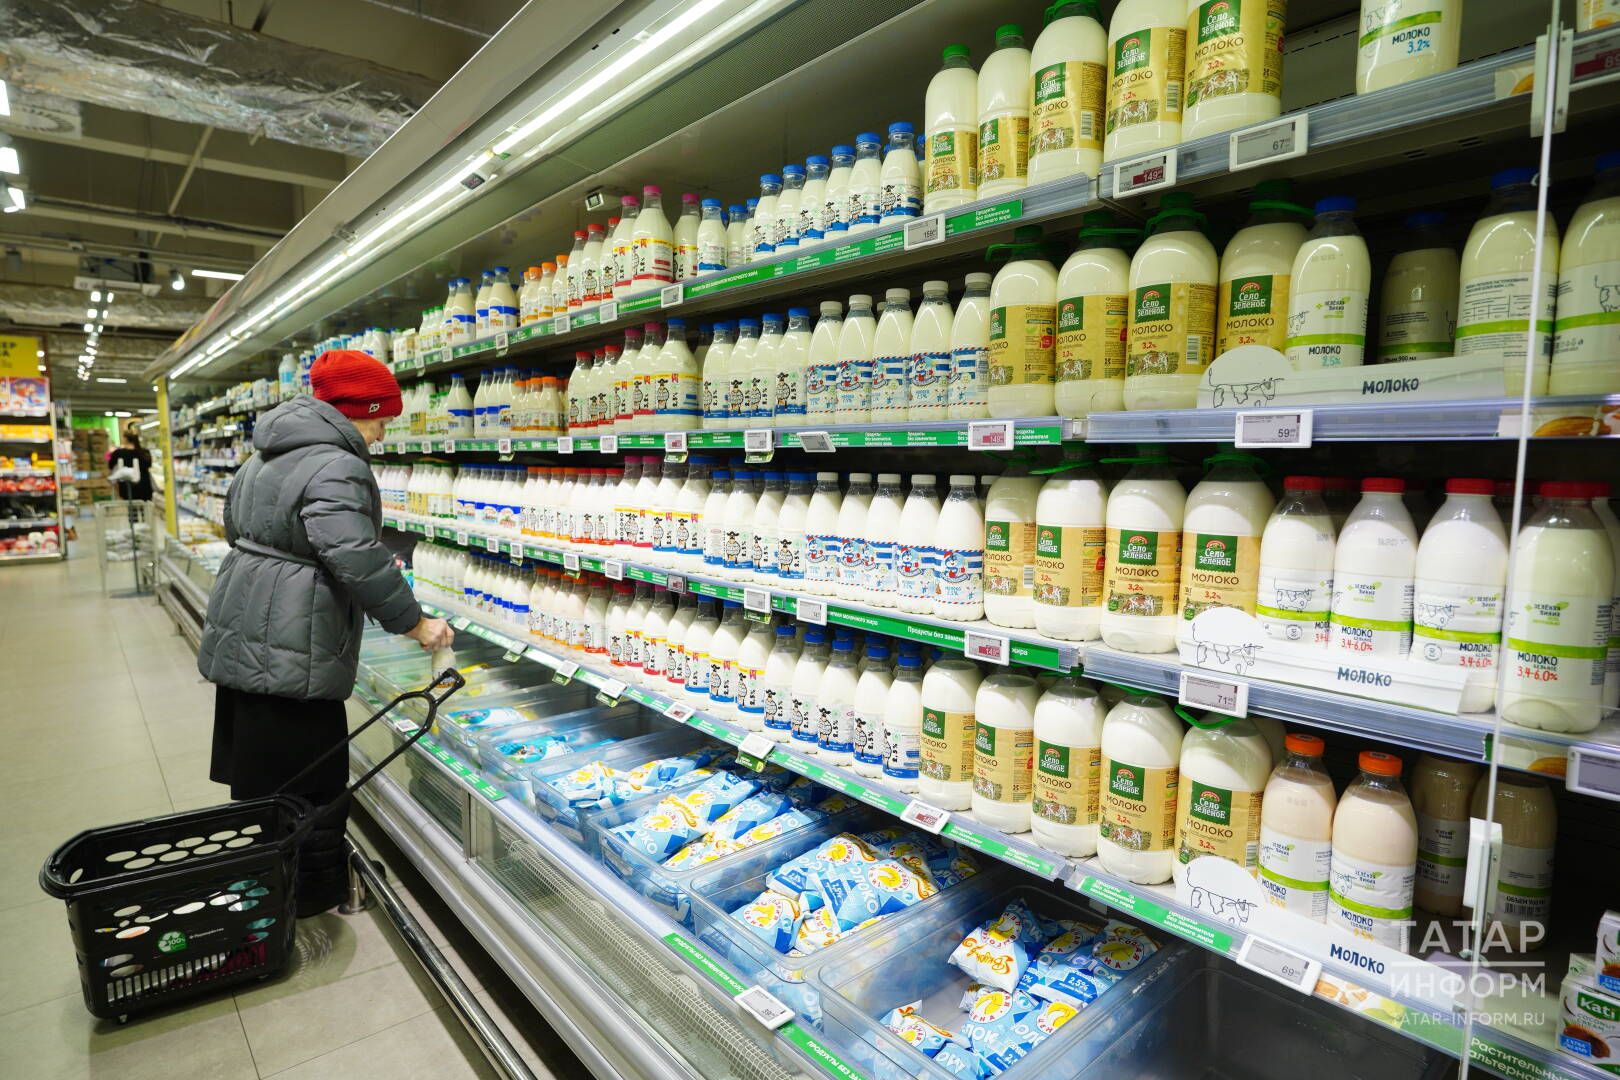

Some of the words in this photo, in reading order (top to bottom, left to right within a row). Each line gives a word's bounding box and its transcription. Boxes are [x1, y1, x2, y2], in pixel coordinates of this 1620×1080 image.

[1207, 12, 1227, 25] Село
[1392, 26, 1431, 44] МОЛОКО
[1194, 37, 1244, 60] МОЛОКО
[1407, 39, 1430, 54] 3.2%
[1111, 70, 1153, 91] МОЛОКО
[1239, 292, 1258, 302] Село
[1142, 300, 1159, 308] Село
[1132, 323, 1173, 336] МОЛОКО
[1226, 317, 1274, 330] МОЛОКО
[1308, 345, 1342, 355] МОЛОКО
[1362, 378, 1419, 395] МОЛОКО
[1128, 543, 1146, 552] Село
[1204, 548, 1224, 558] Село
[1116, 566, 1159, 578] МОЛОКО
[1192, 572, 1240, 585] МОЛОКО
[908, 626, 932, 638] Продукты
[934, 630, 944, 639] без
[1342, 626, 1372, 638] МОЛОКО
[1341, 638, 1372, 652] 3.4-6.0%
[1459, 643, 1493, 652] МОЛОКО
[1518, 652, 1558, 666] МОЛОКО
[1338, 667, 1392, 686] МОЛОКО
[1518, 666, 1558, 682] 3.4-6.0%
[1116, 776, 1134, 786] Село
[1106, 794, 1146, 812] МОЛОКО
[1200, 798, 1219, 810] Село
[1186, 818, 1233, 838] МОЛОКО
[1342, 910, 1373, 926] МОЛОКО
[1330, 944, 1385, 974] МОЛОКО
[1580, 998, 1616, 1020] Kati
[807, 1040, 840, 1066] ПРОДУКТЫ
[838, 1063, 850, 1074] БЕЗ
